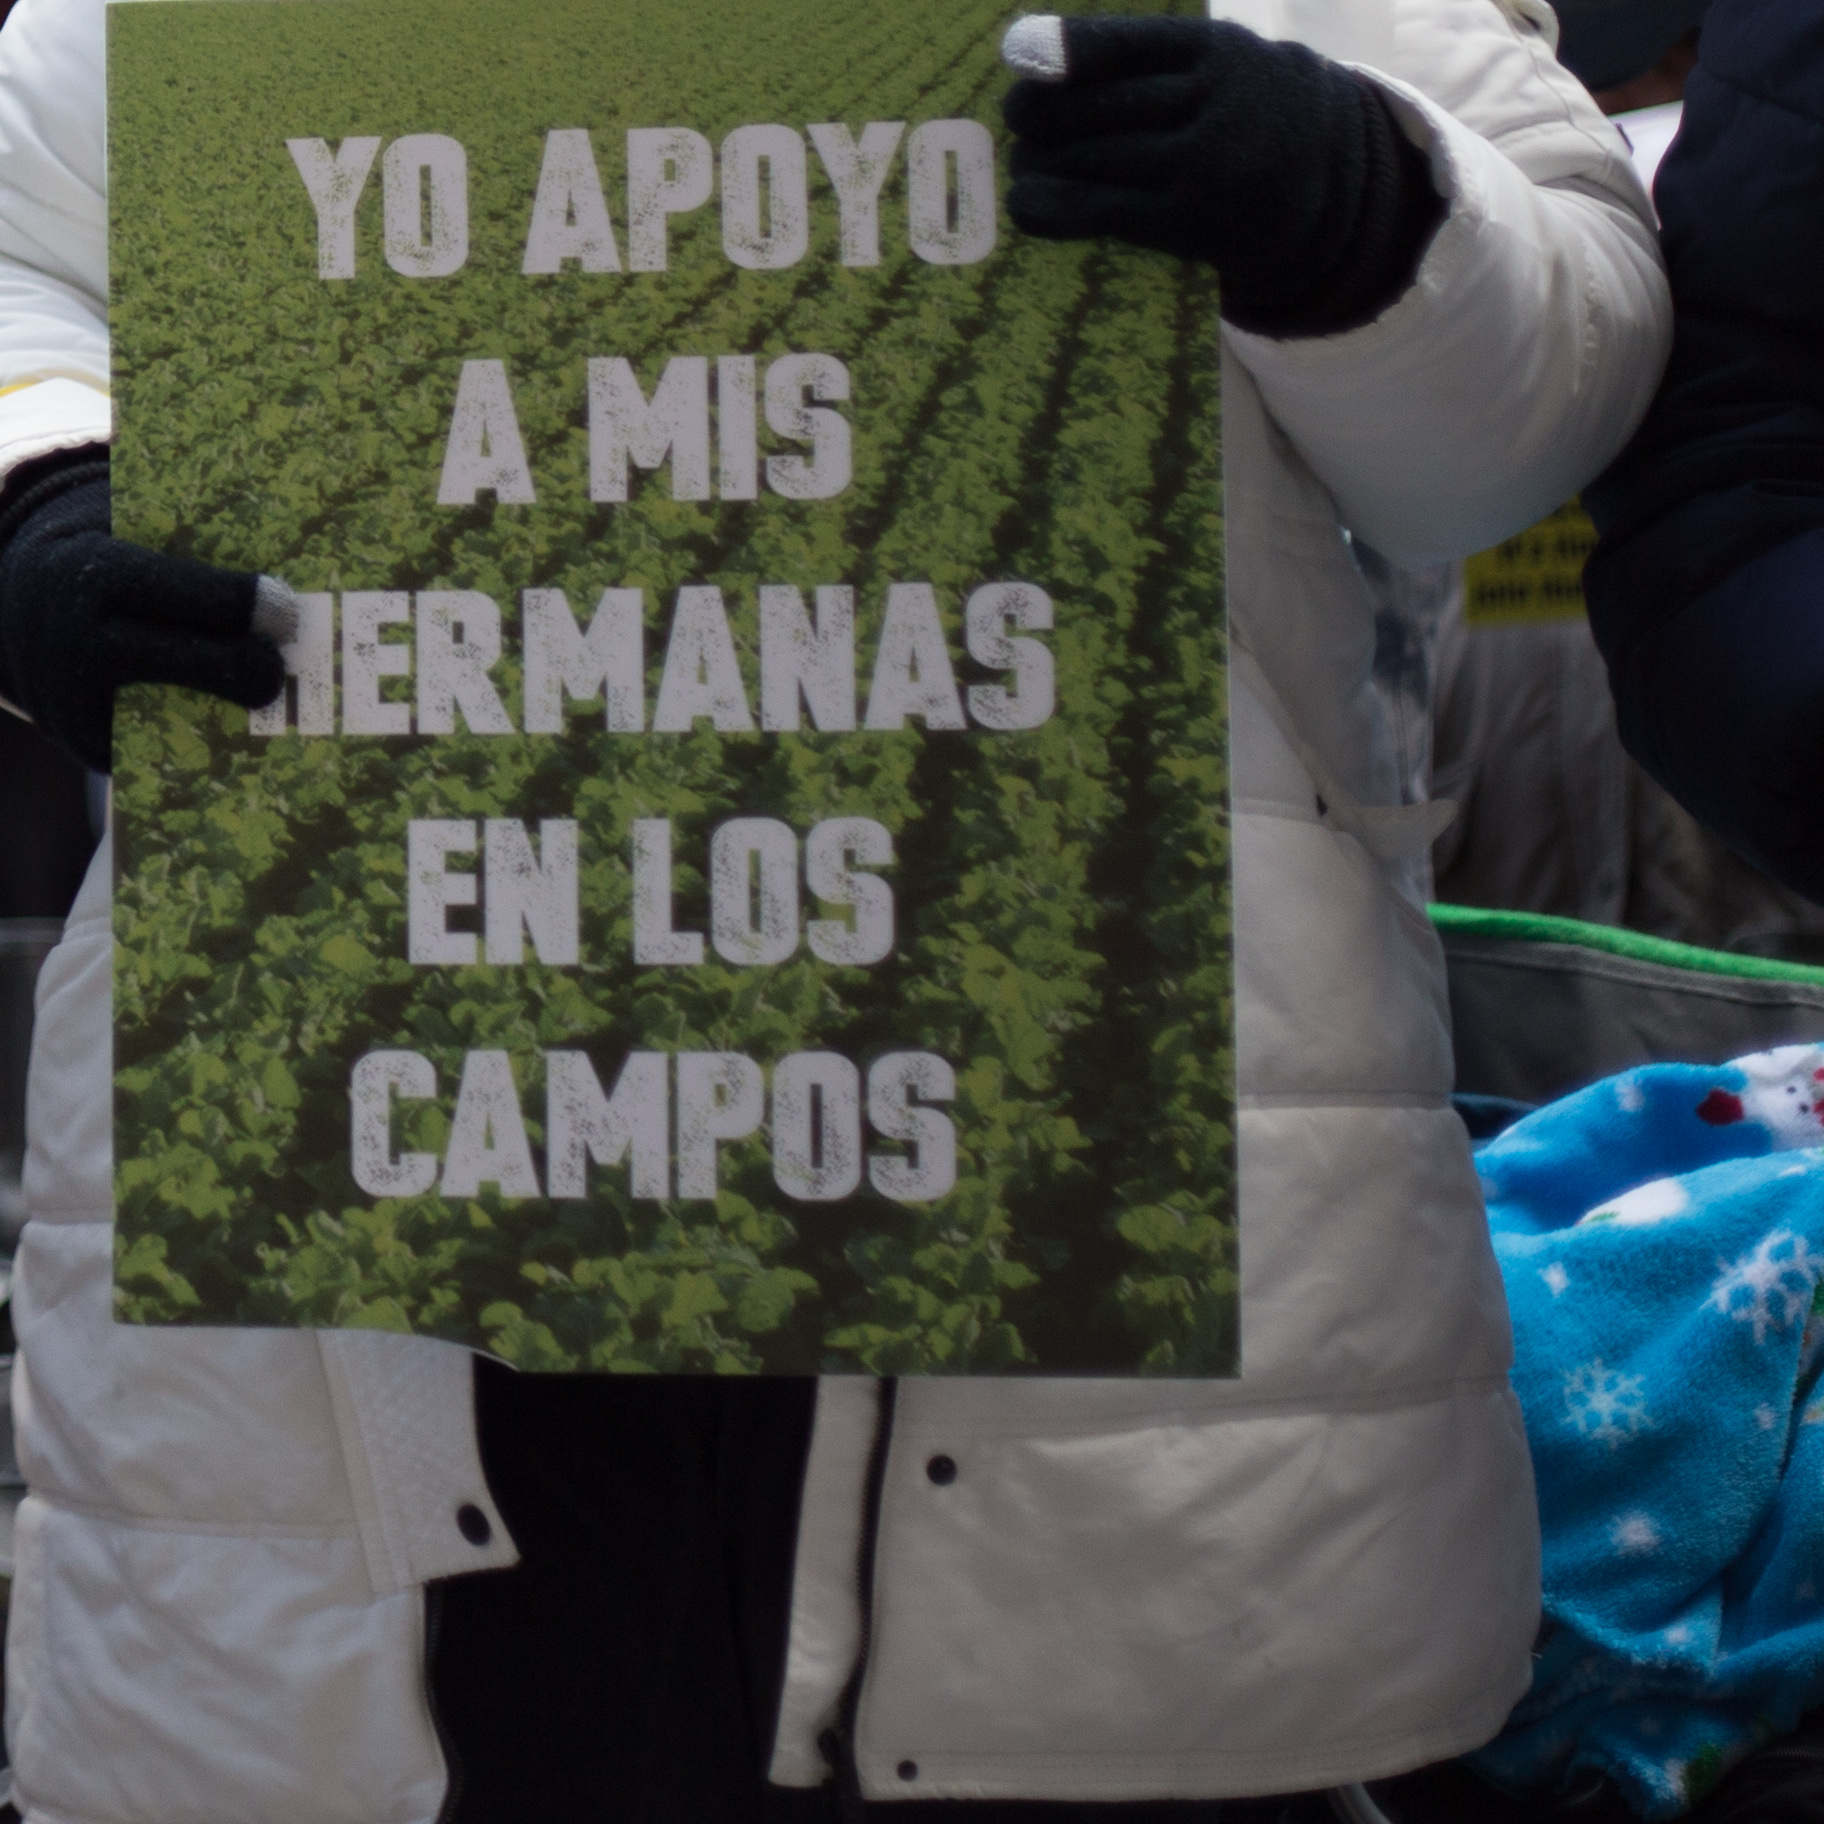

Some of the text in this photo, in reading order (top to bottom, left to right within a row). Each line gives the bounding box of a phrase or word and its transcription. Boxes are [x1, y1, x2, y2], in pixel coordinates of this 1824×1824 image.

[285, 117, 997, 282] YO APOYO
[436, 351, 853, 506] A MIS
[407, 815, 895, 967] EN LOS
[351, 1049, 956, 1203] CAMPOS
